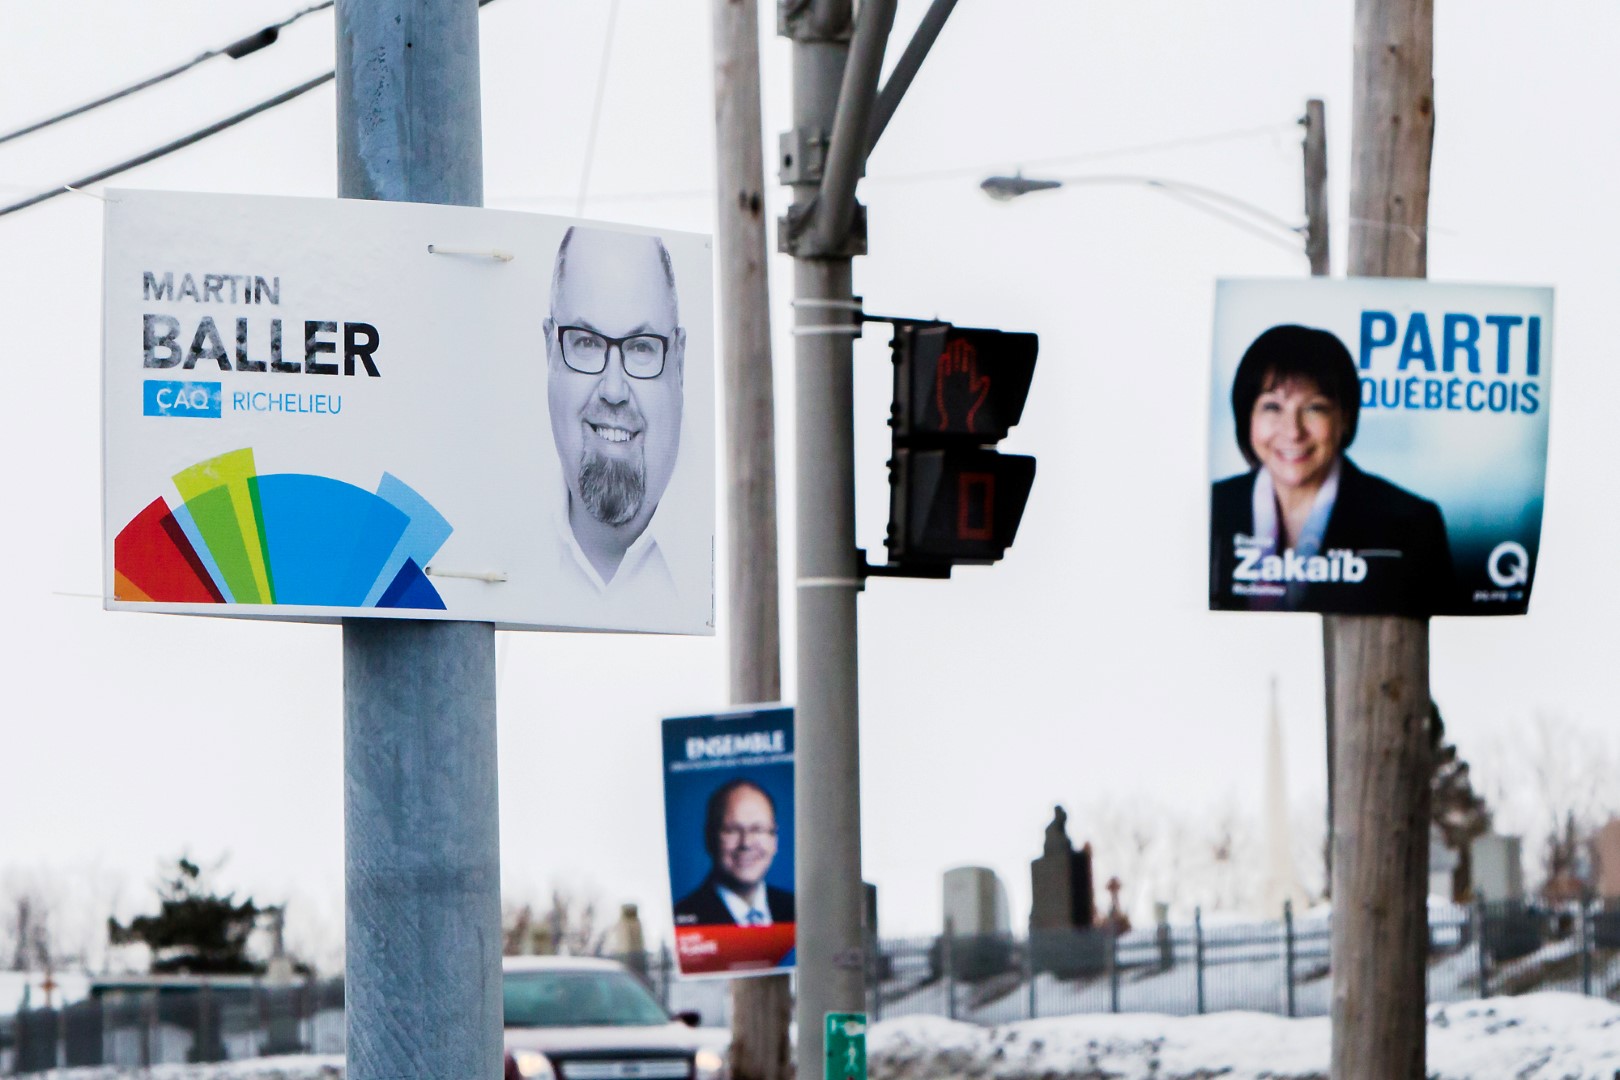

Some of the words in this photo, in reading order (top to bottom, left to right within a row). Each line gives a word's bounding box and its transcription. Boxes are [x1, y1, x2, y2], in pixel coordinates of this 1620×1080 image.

[143, 271, 280, 305] MARTIN
[143, 313, 382, 378] BALLER
[1359, 310, 1541, 377] PARTI
[156, 388, 210, 410] CAQ
[232, 392, 343, 415] RICHELIEU
[1360, 376, 1541, 415] QUÉBÉCOIS
[1233, 547, 1368, 583] Zakaïb
[1487, 541, 1529, 588] Q
[686, 730, 785, 760] ENSEMBLE
